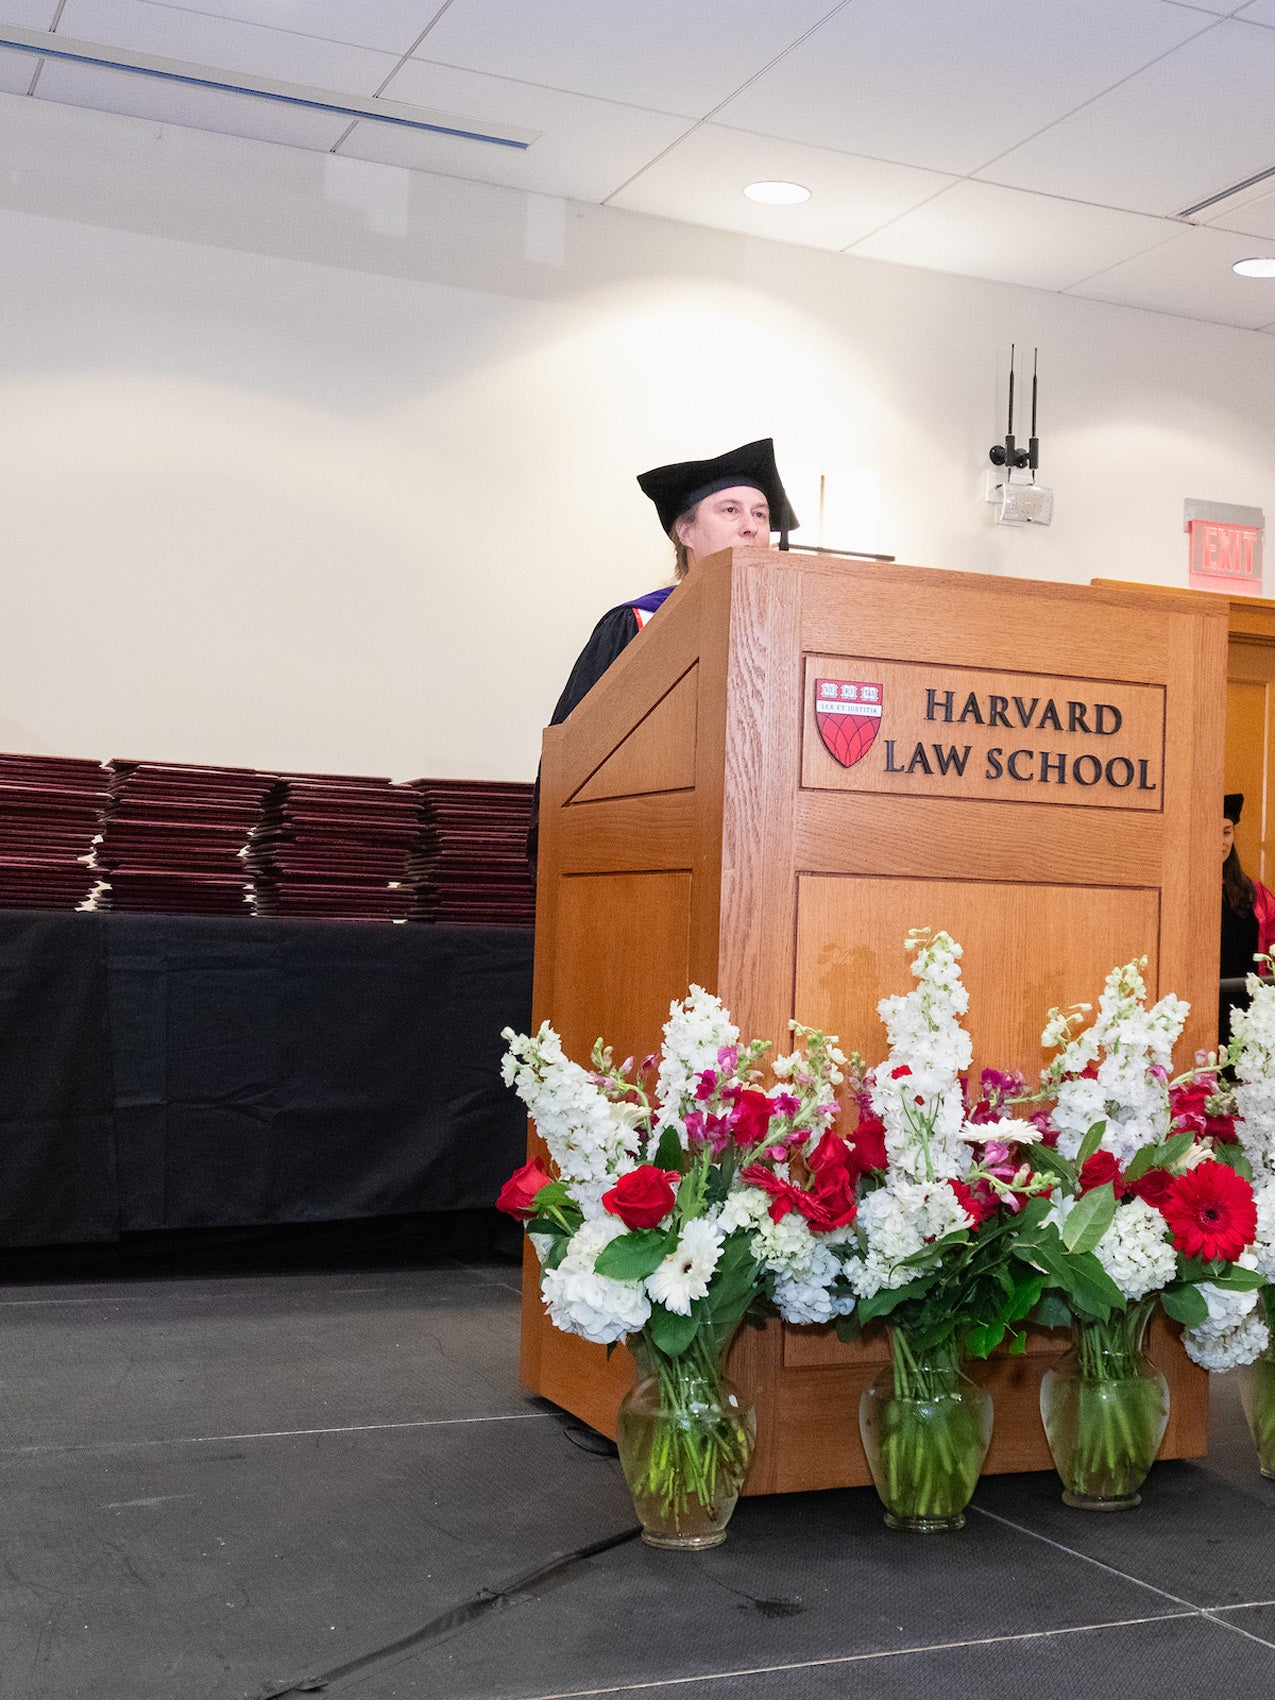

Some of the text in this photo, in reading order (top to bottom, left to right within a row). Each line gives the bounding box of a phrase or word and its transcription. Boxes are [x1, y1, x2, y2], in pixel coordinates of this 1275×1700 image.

[1203, 526, 1257, 575] EXIT
[821, 703, 835, 711] LEX
[924, 688, 1123, 735] HARVARD
[884, 740, 1156, 790] LAW SCHOOL
